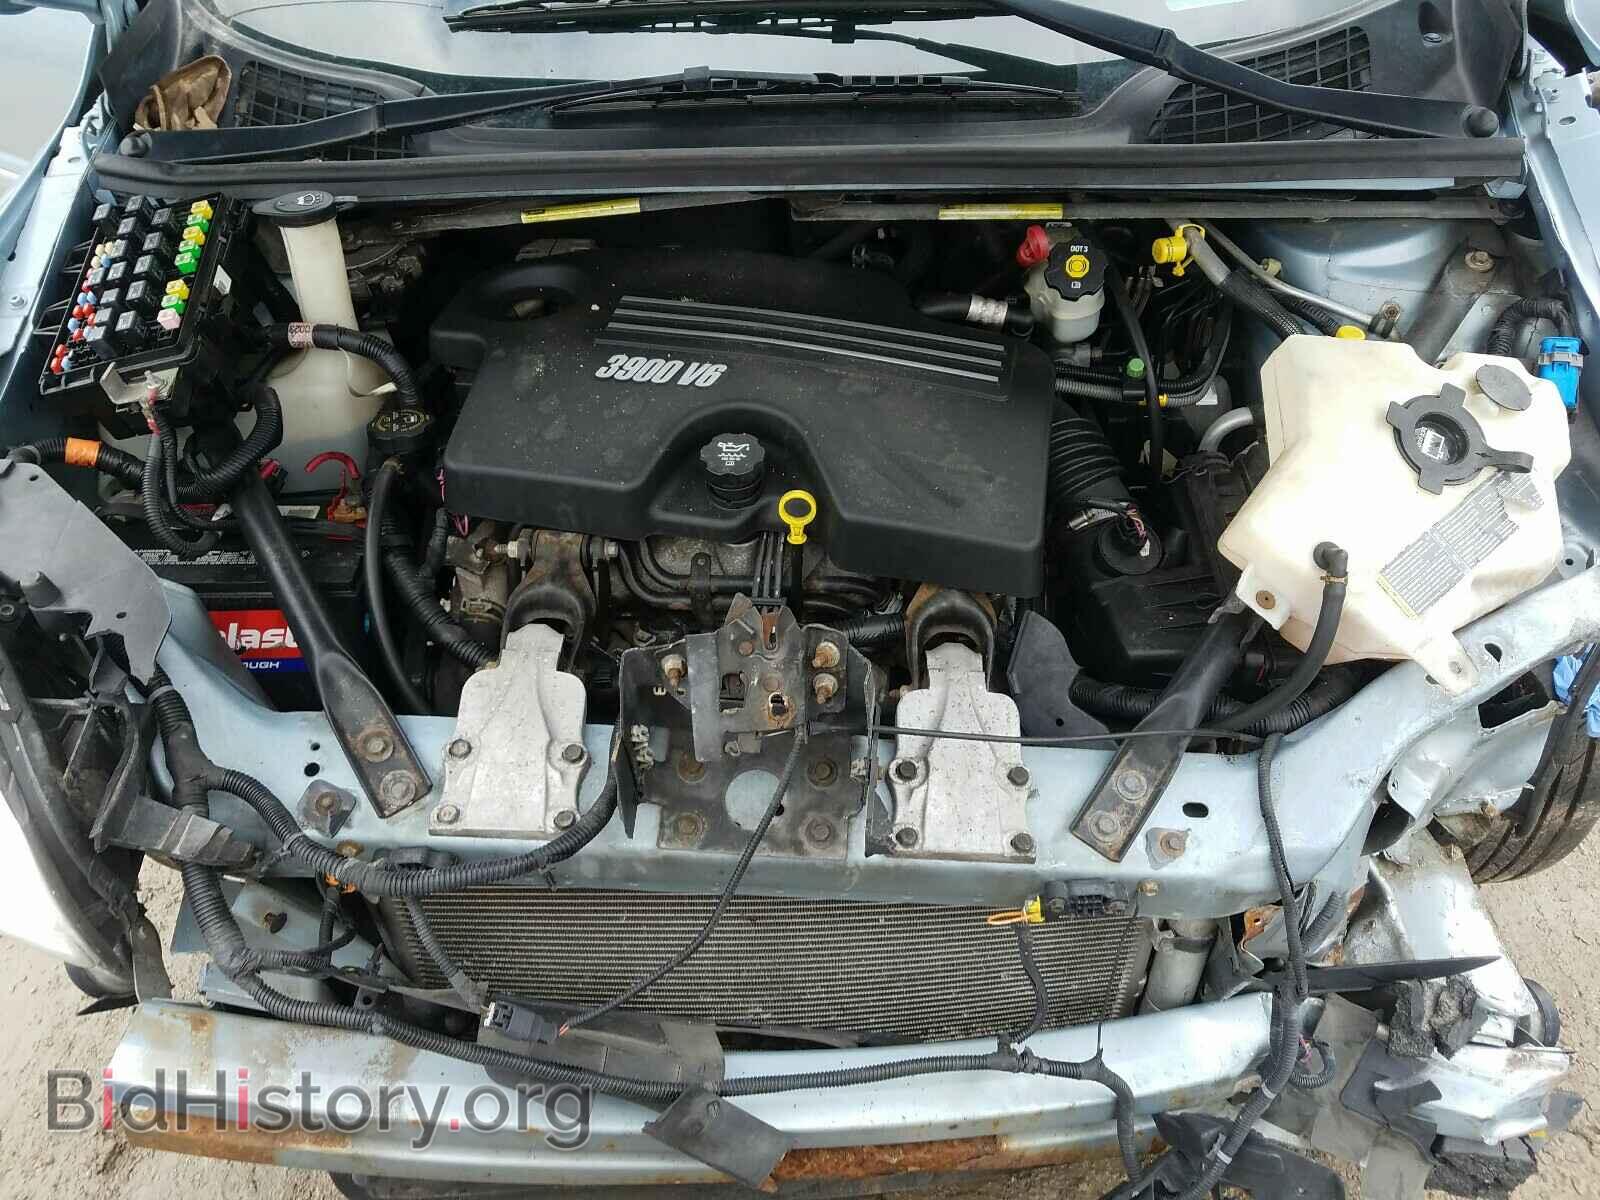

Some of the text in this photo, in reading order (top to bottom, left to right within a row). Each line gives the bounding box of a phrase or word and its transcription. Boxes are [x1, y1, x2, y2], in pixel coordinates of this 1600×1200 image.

[1071, 245, 1089, 253] DOT 3
[595, 354, 728, 387] 3900 V6
